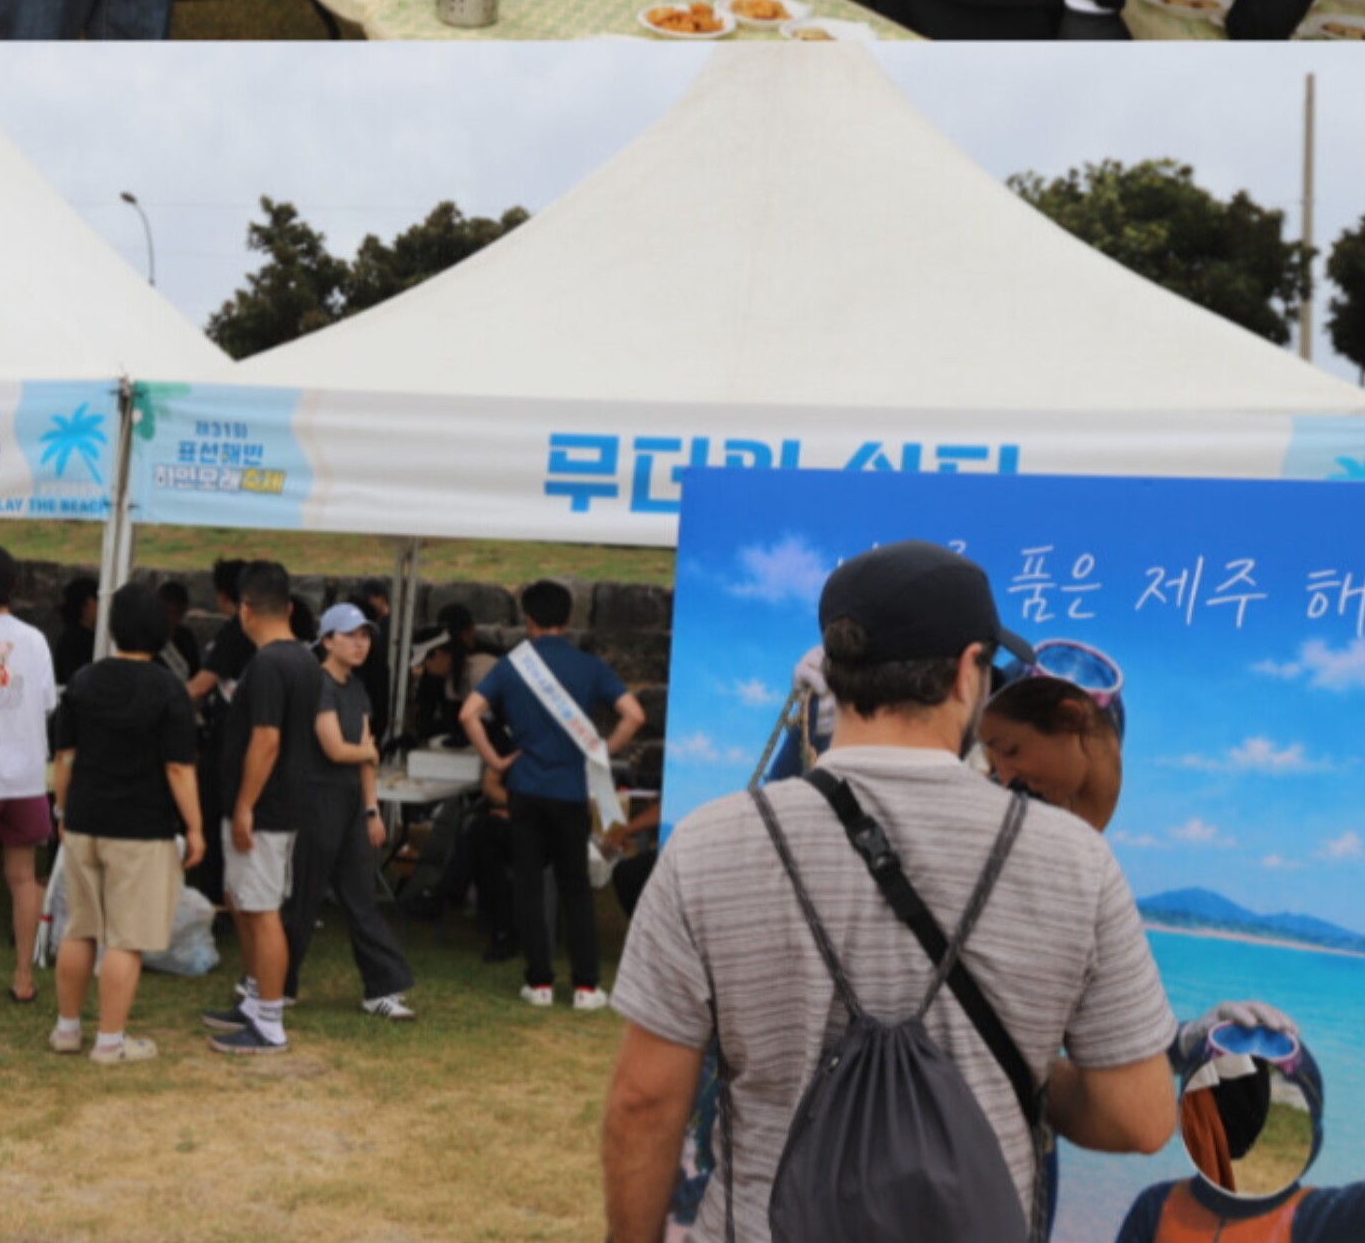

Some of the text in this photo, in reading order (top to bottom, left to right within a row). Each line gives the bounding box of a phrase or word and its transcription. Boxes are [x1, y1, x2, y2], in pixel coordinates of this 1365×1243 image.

[178, 440, 263, 466] 표선해변
[1007, 545, 1102, 623] 품은
[1135, 555, 1268, 629] 제주
